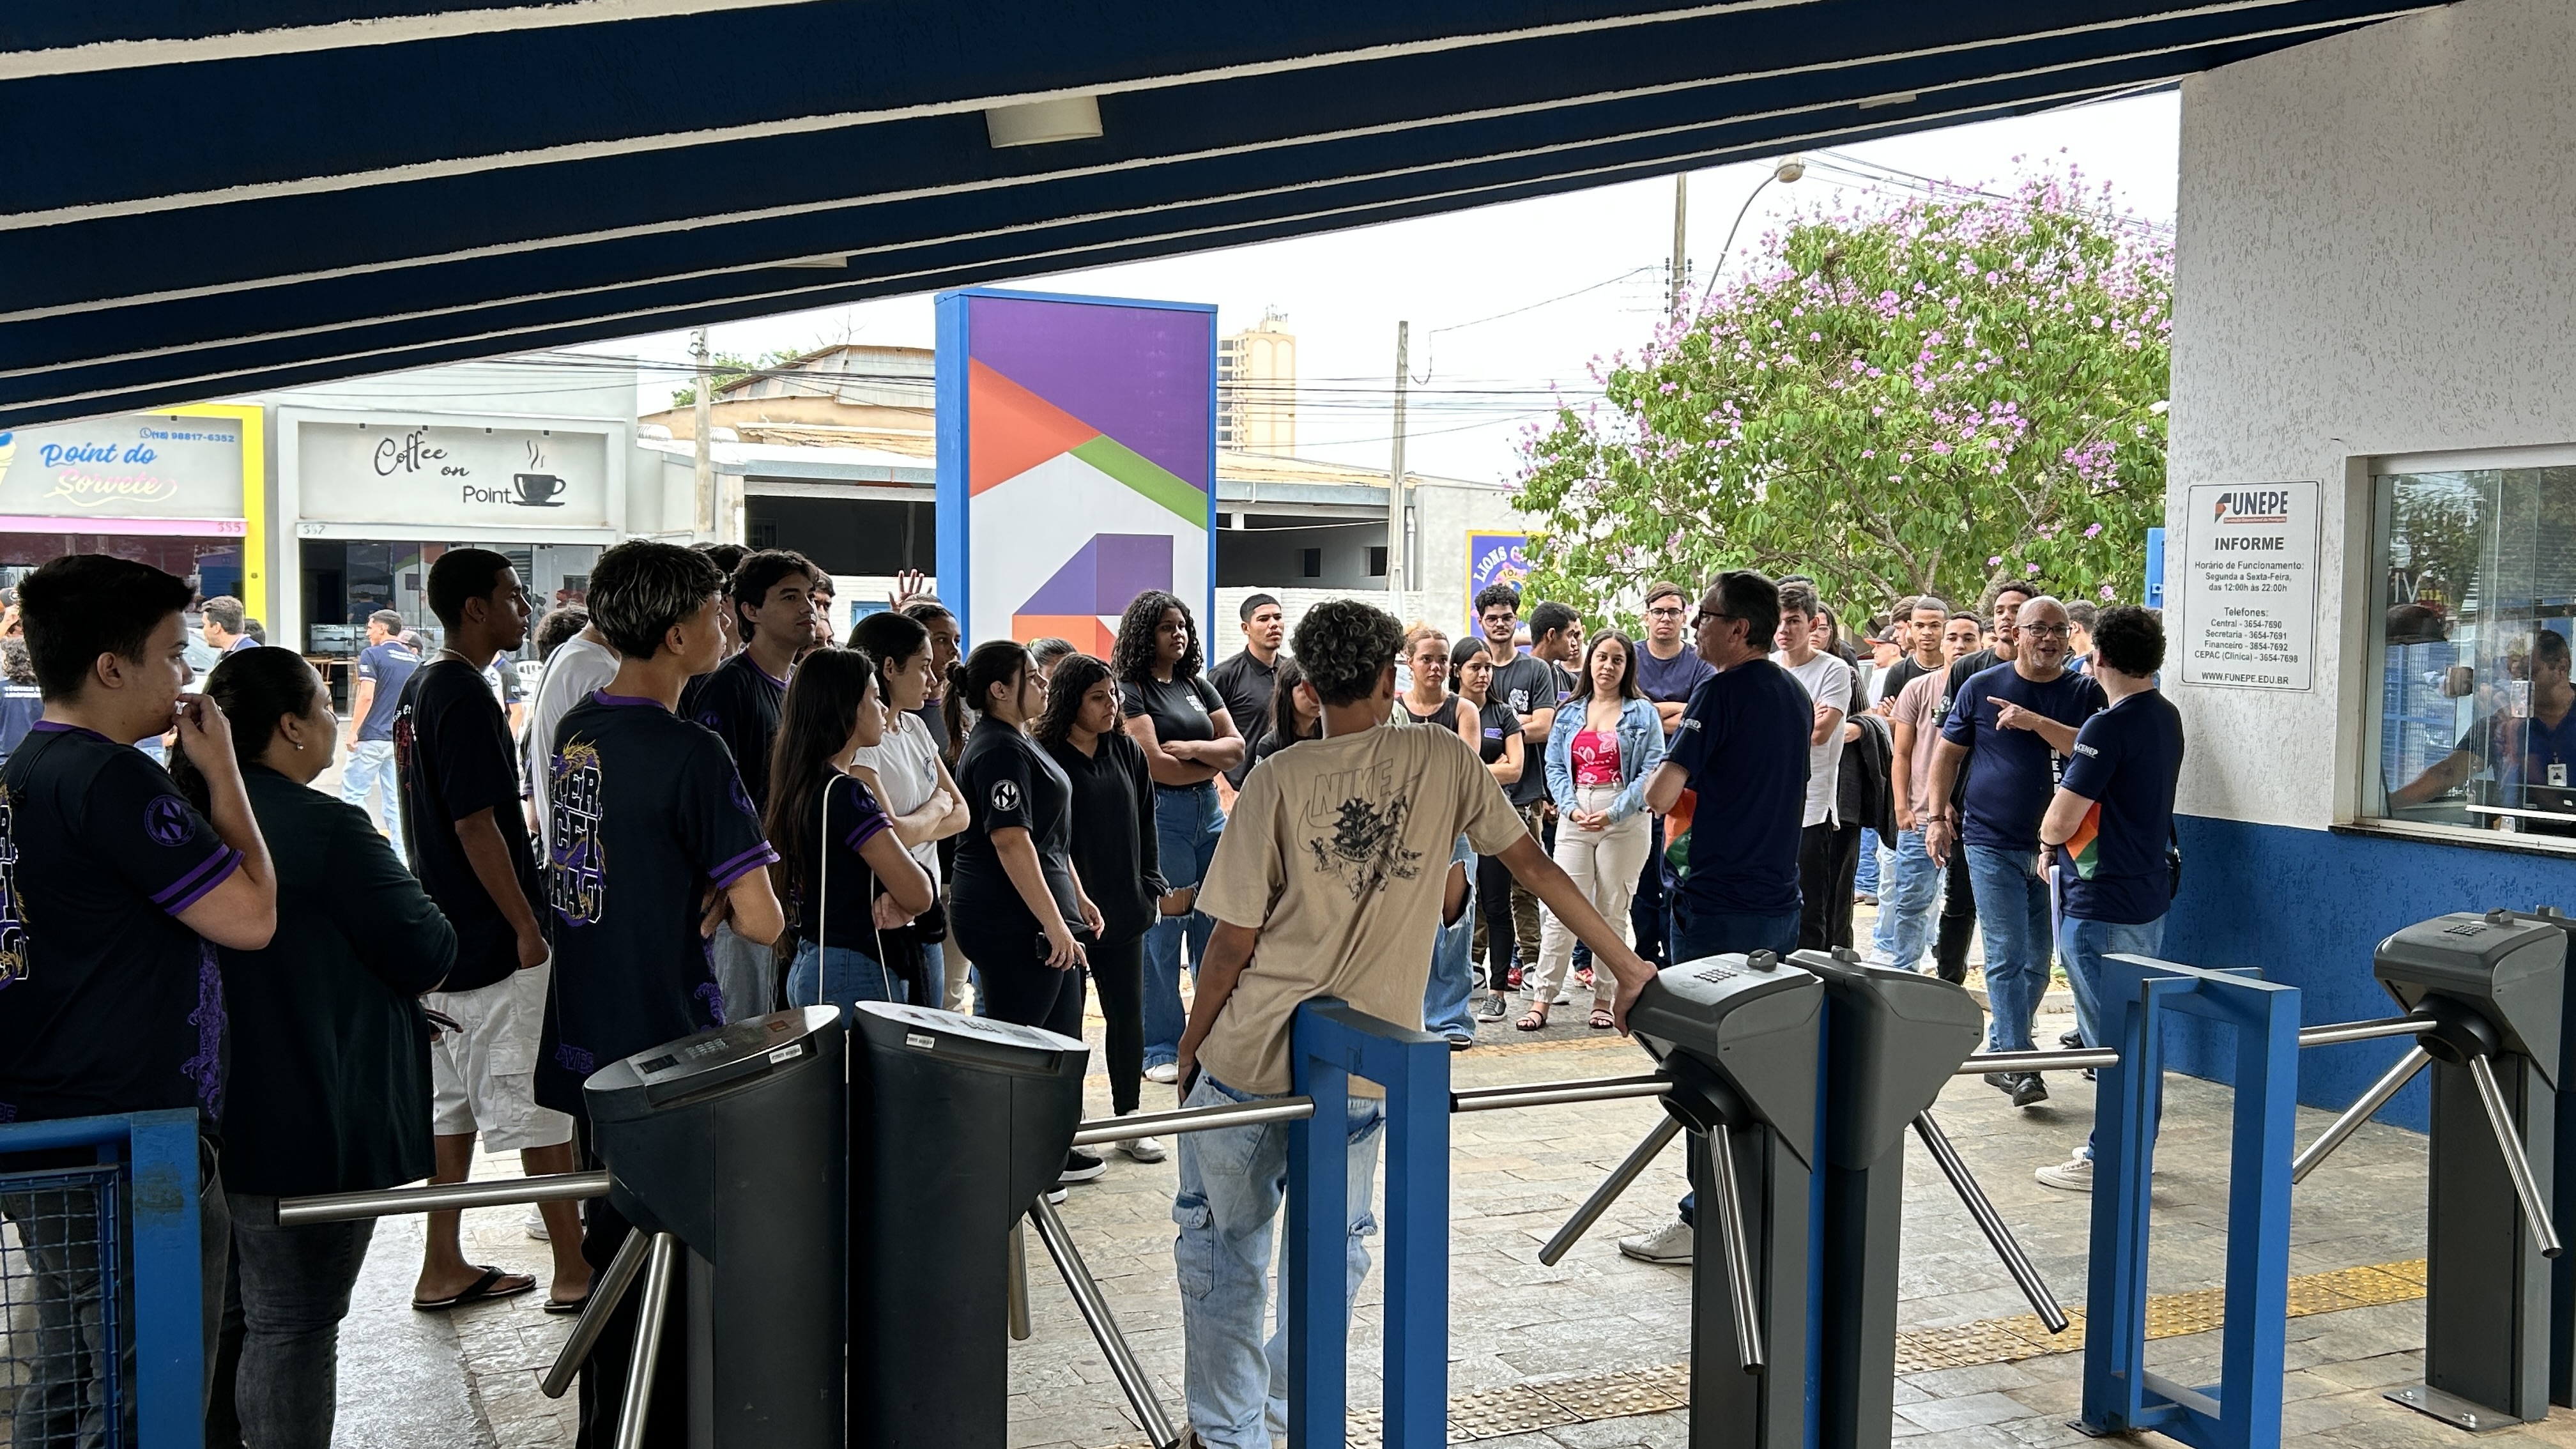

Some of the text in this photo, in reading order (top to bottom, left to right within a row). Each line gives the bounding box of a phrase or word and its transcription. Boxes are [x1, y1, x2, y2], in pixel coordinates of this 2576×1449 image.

[40, 442, 158, 468] Point do
[374, 431, 447, 475] Coffee
[441, 465, 470, 477] on
[43, 468, 178, 507] Sorvete
[463, 485, 512, 503] Point
[2214, 491, 2288, 523] FUNEPE
[2214, 537, 2285, 551] INFORME
[1473, 546, 1508, 583] LIONS
[2195, 561, 2223, 570] Horário
[2237, 561, 2304, 570] Funcionamento:
[2205, 572, 2238, 582] Segunda
[2246, 572, 2292, 583] Sexta-Feira,
[2225, 583, 2249, 592] 12:00h
[2250, 583, 2260, 592] às
[2261, 584, 2288, 592] 22:00h
[2224, 607, 2269, 617] Telefones:
[2211, 618, 2237, 627] Central
[2244, 620, 2282, 629] 3654-7690
[2205, 629, 2242, 638] Secretaria
[2249, 631, 2287, 640] 3654-7691
[2204, 640, 2243, 650] Financeiro
[2250, 641, 2288, 652] 3654-7692
[2194, 650, 2220, 659] CEPAC
[2222, 651, 2253, 662] (Clínica)
[2259, 653, 2299, 663] 3654-7698
[2202, 671, 2289, 685] WWW.FUNEPE.EDU.BR
[1311, 758, 1393, 818] NIKE
